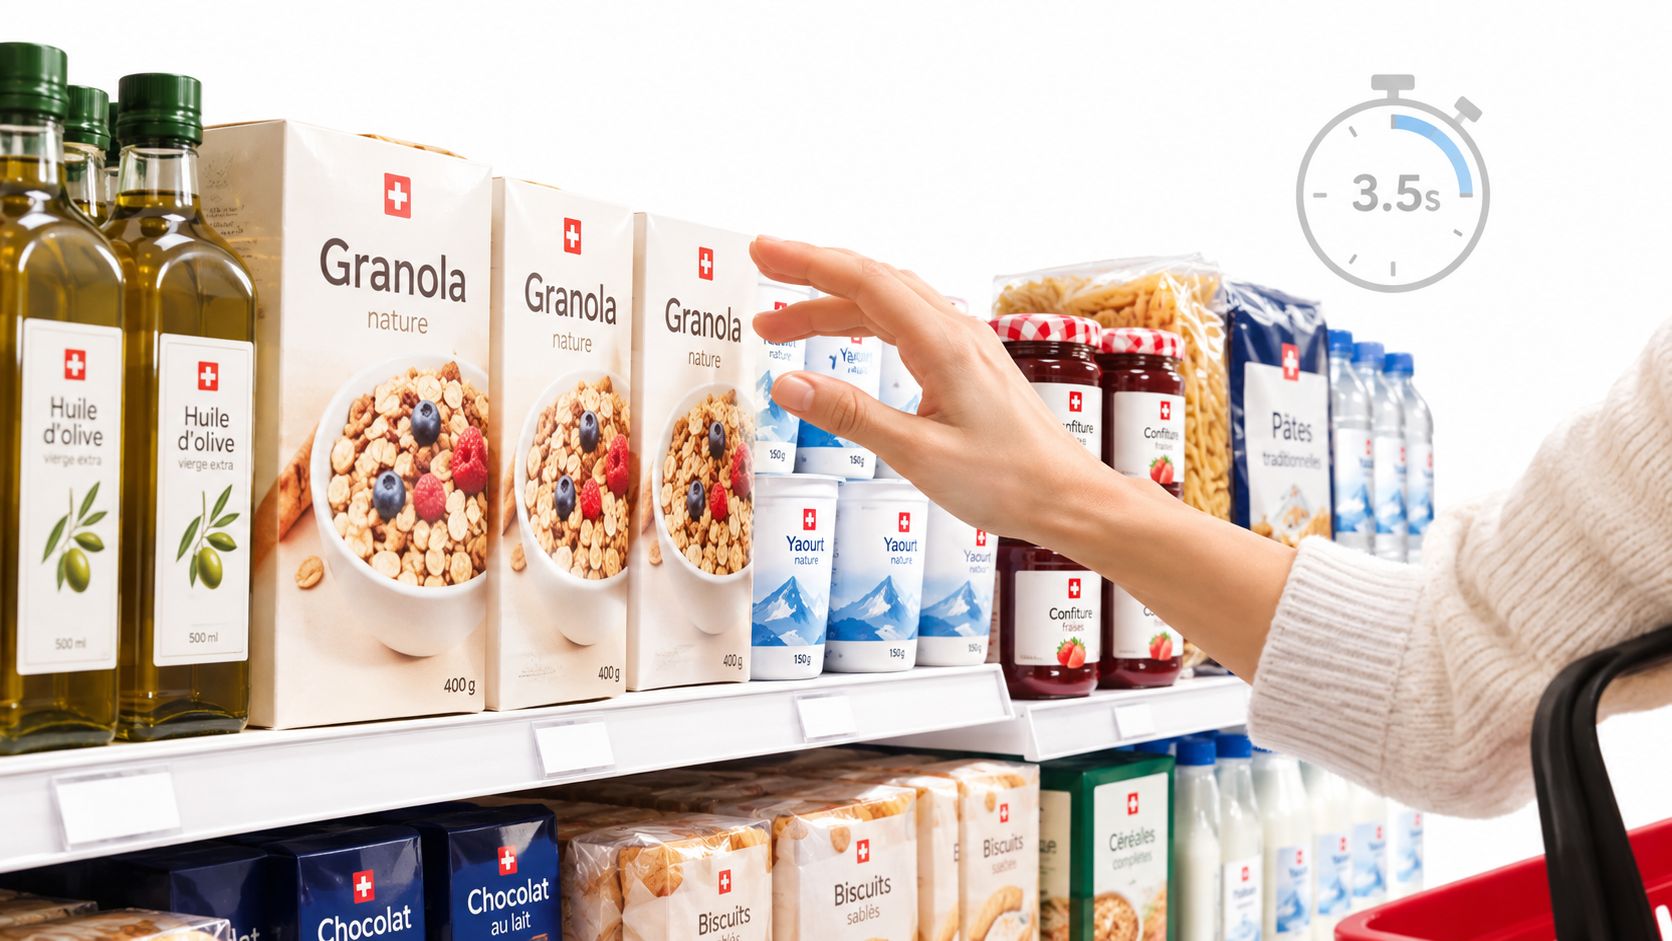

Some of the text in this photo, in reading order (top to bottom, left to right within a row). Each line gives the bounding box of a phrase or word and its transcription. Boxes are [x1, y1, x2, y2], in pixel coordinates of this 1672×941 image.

[320, 238, 467, 302] Granola
[525, 272, 617, 325] Granola
[367, 308, 429, 335] nature
[665, 297, 742, 344] Granola
[553, 331, 593, 354] nature
[688, 349, 722, 370] nature
[50, 396, 98, 421] Huile
[184, 405, 230, 428] Huile
[43, 423, 104, 447] d'olive
[1062, 420, 1094, 434] nfiture
[178, 430, 235, 453] d'olive
[43, 454, 103, 468] vierge extra
[178, 458, 234, 472] vierge extra
[786, 535, 825, 552] Yaourt
[883, 537, 918, 552] Yaourt
[794, 556, 819, 565] nature
[1049, 607, 1093, 620] Confiture
[55, 637, 87, 650] 500 ml
[189, 632, 219, 644] 500 ml
[983, 833, 1024, 859] Biscuits
[1108, 826, 1156, 852] Céréales
[468, 878, 549, 915] Chocolat
[834, 875, 892, 906] Biscuits
[317, 904, 412, 941] Chocolat
[490, 911, 531, 936] au lait
[698, 904, 751, 936] Biscuits
